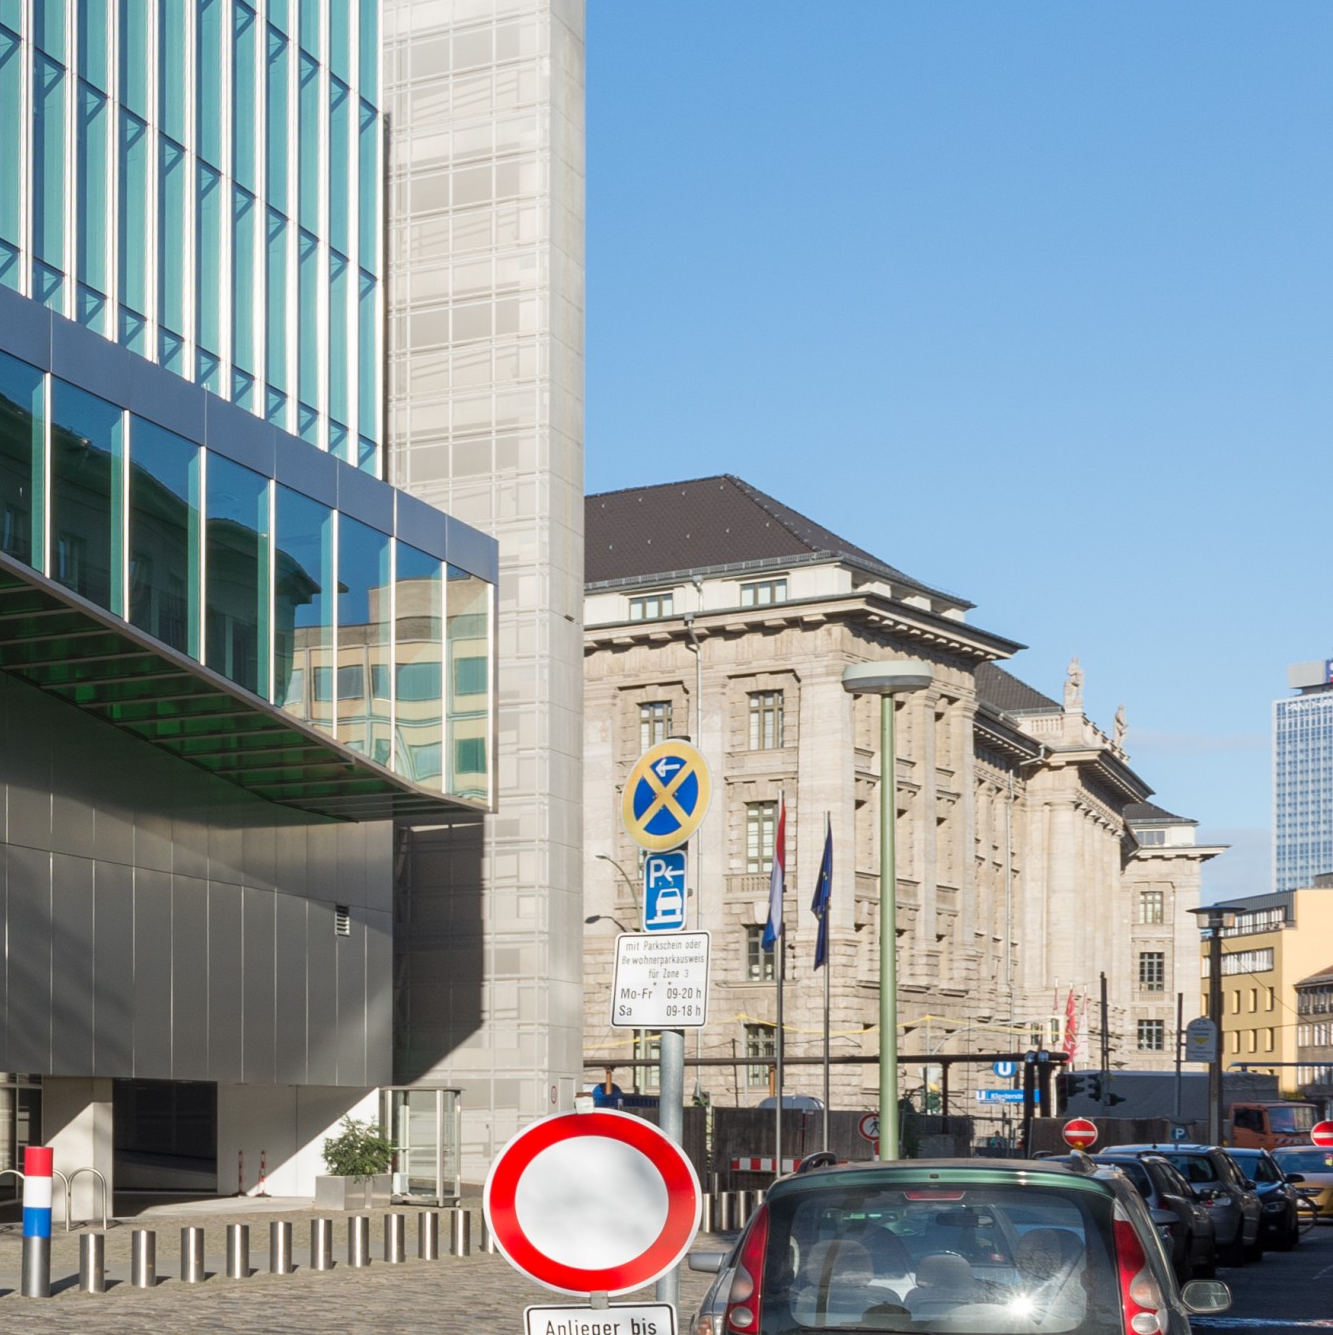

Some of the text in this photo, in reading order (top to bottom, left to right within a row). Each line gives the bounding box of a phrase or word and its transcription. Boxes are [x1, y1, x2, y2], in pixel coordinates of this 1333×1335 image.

[650, 859, 666, 888] P
[626, 940, 701, 951] mit Parkschein oder
[648, 968, 689, 978] für Zone 3
[620, 987, 702, 999] Mo-Fr 09-20 h
[619, 1005, 701, 1016] Sa 09-18 h
[997, 1061, 1012, 1076] U
[631, 1317, 658, 1335] bis
